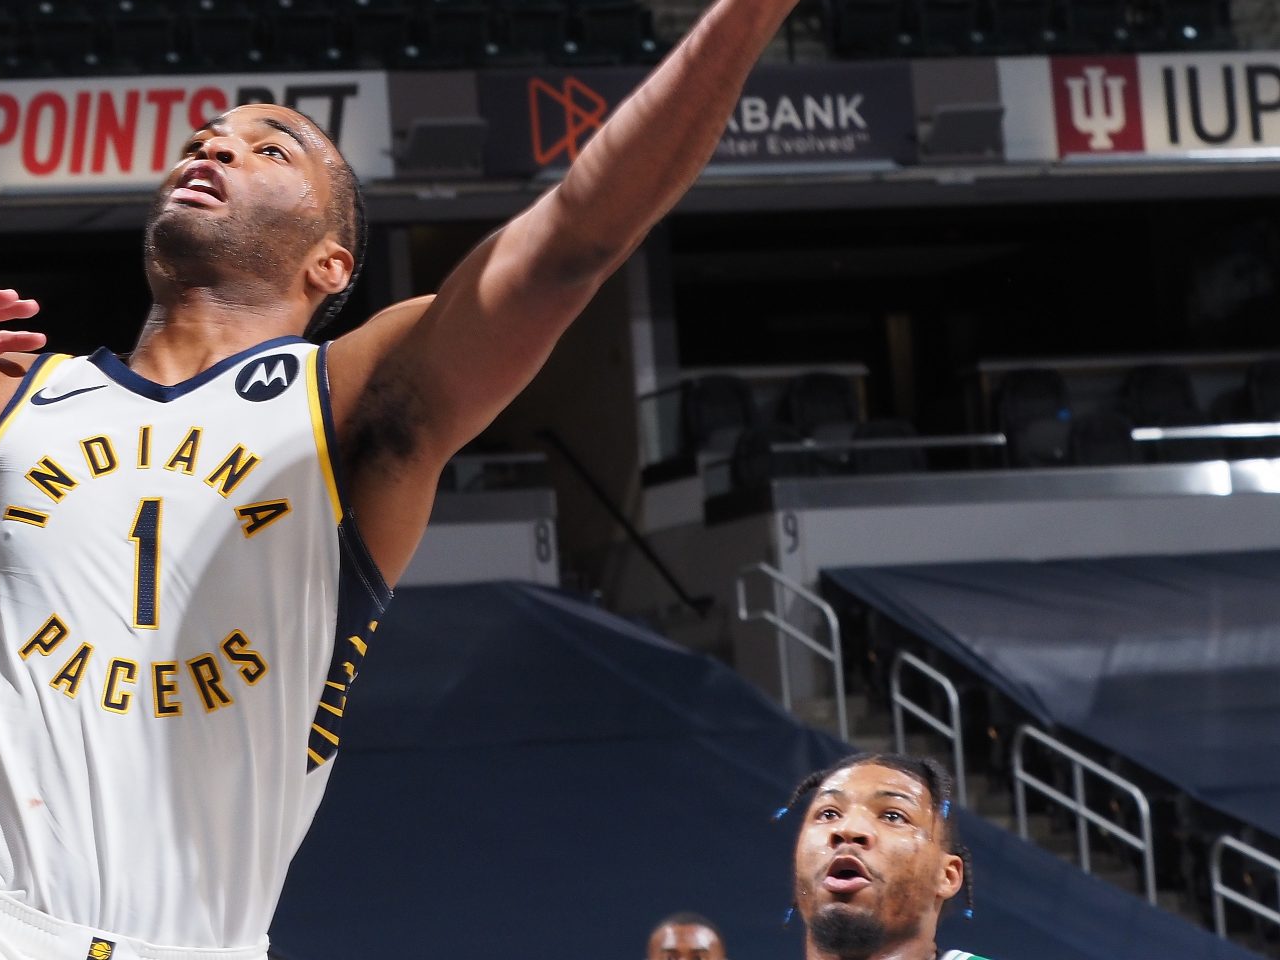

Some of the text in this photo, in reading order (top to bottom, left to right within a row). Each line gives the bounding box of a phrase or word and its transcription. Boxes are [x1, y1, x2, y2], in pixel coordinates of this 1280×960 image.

[727, 94, 868, 133] BANK
[3, 423, 294, 539] INDIANA
[127, 496, 164, 630] 1
[534, 520, 552, 564] 8
[782, 511, 799, 554] 9
[18, 613, 270, 719] PACERS
